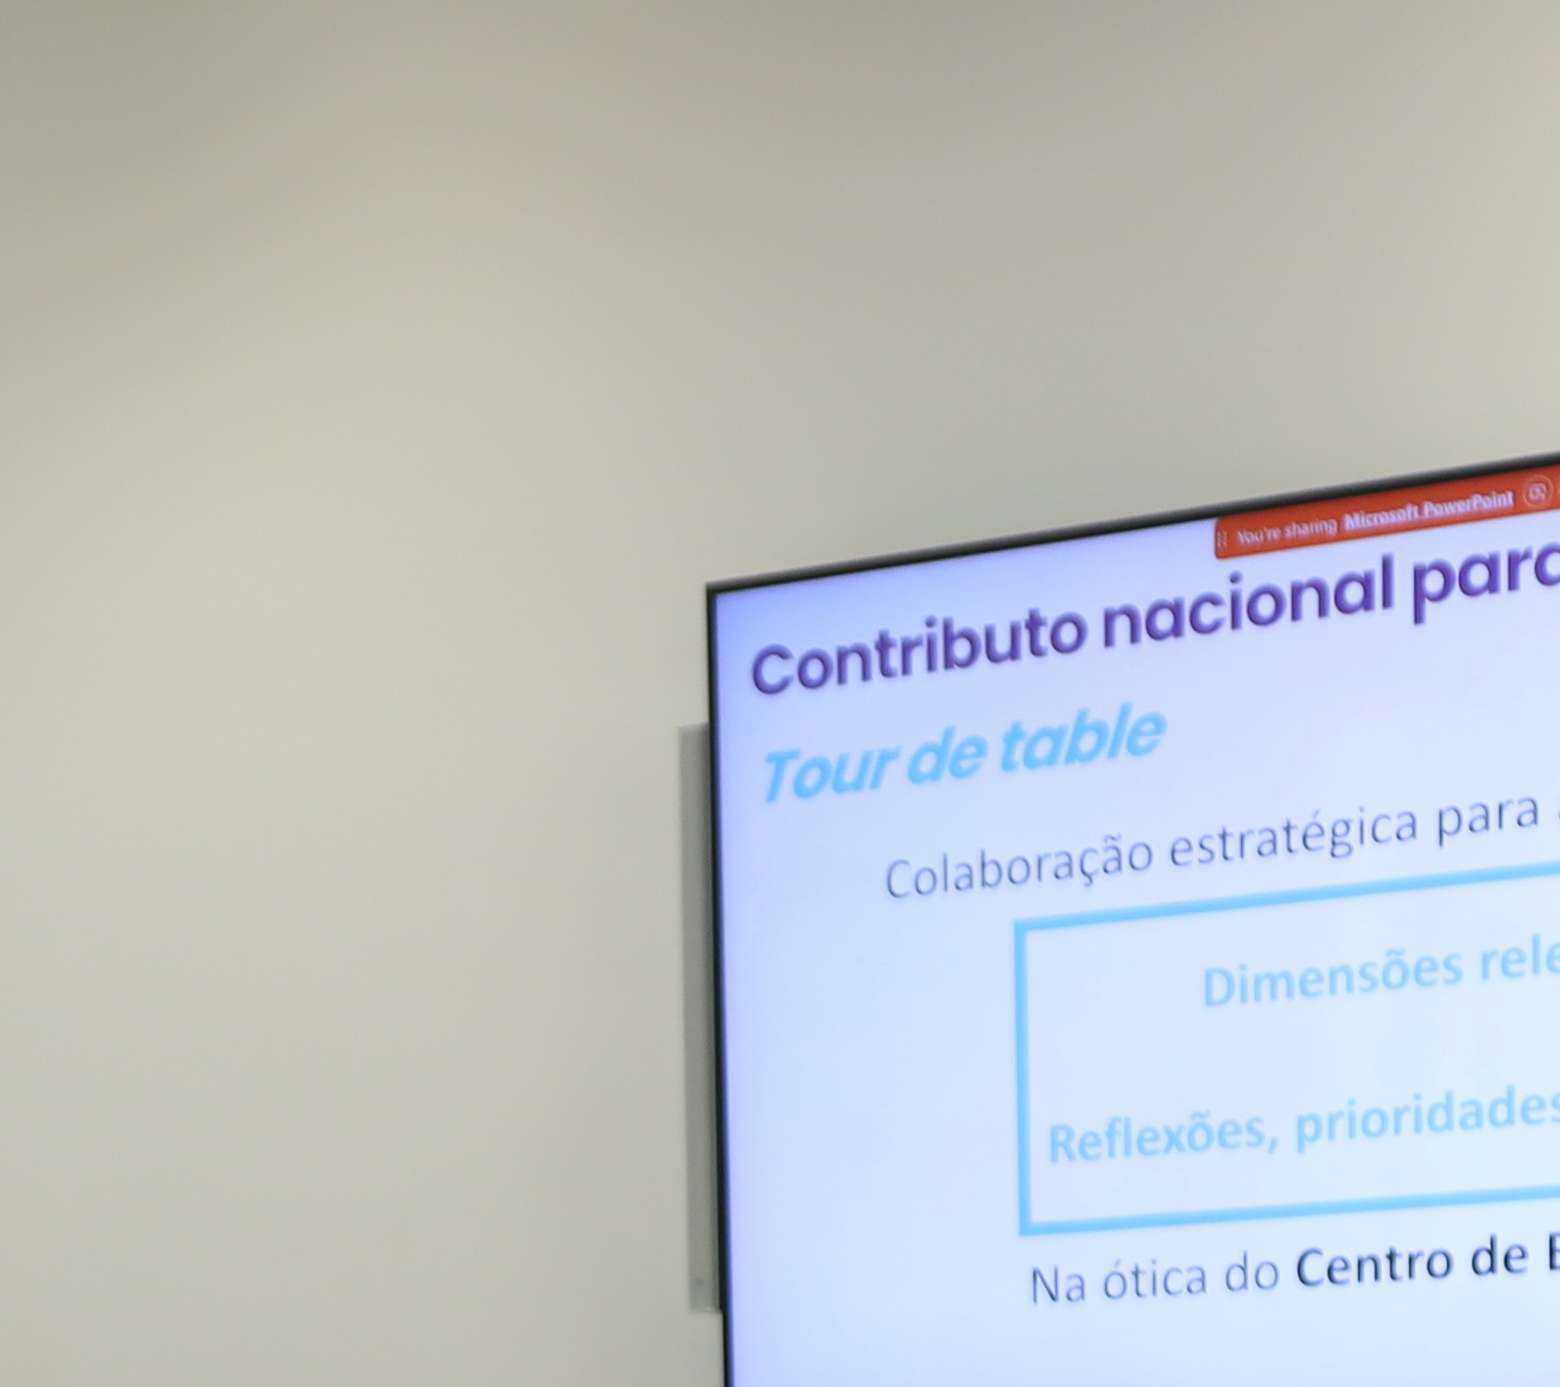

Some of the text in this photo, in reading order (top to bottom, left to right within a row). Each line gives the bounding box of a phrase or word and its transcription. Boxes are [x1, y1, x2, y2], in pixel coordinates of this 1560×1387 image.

[1284, 518, 1338, 539] sharing
[1344, 502, 1420, 530] Microsoft
[1423, 490, 1514, 519] PowerPoint
[751, 608, 1088, 696] Contributo
[1103, 553, 1394, 649] nacional
[765, 702, 1168, 804] Tour de table
[886, 835, 1153, 899] Colaboração
[1169, 807, 1417, 867] estratégica
[1438, 797, 1538, 848] para
[1203, 948, 1463, 1008] Dimensões
[1048, 1112, 1278, 1164] Reflexões,
[1032, 1266, 1086, 1304] Na
[1103, 1259, 1206, 1300] ótica
[1225, 1250, 1280, 1293] do
[1296, 1246, 1454, 1288] Centro
[1471, 1233, 1529, 1278] de
